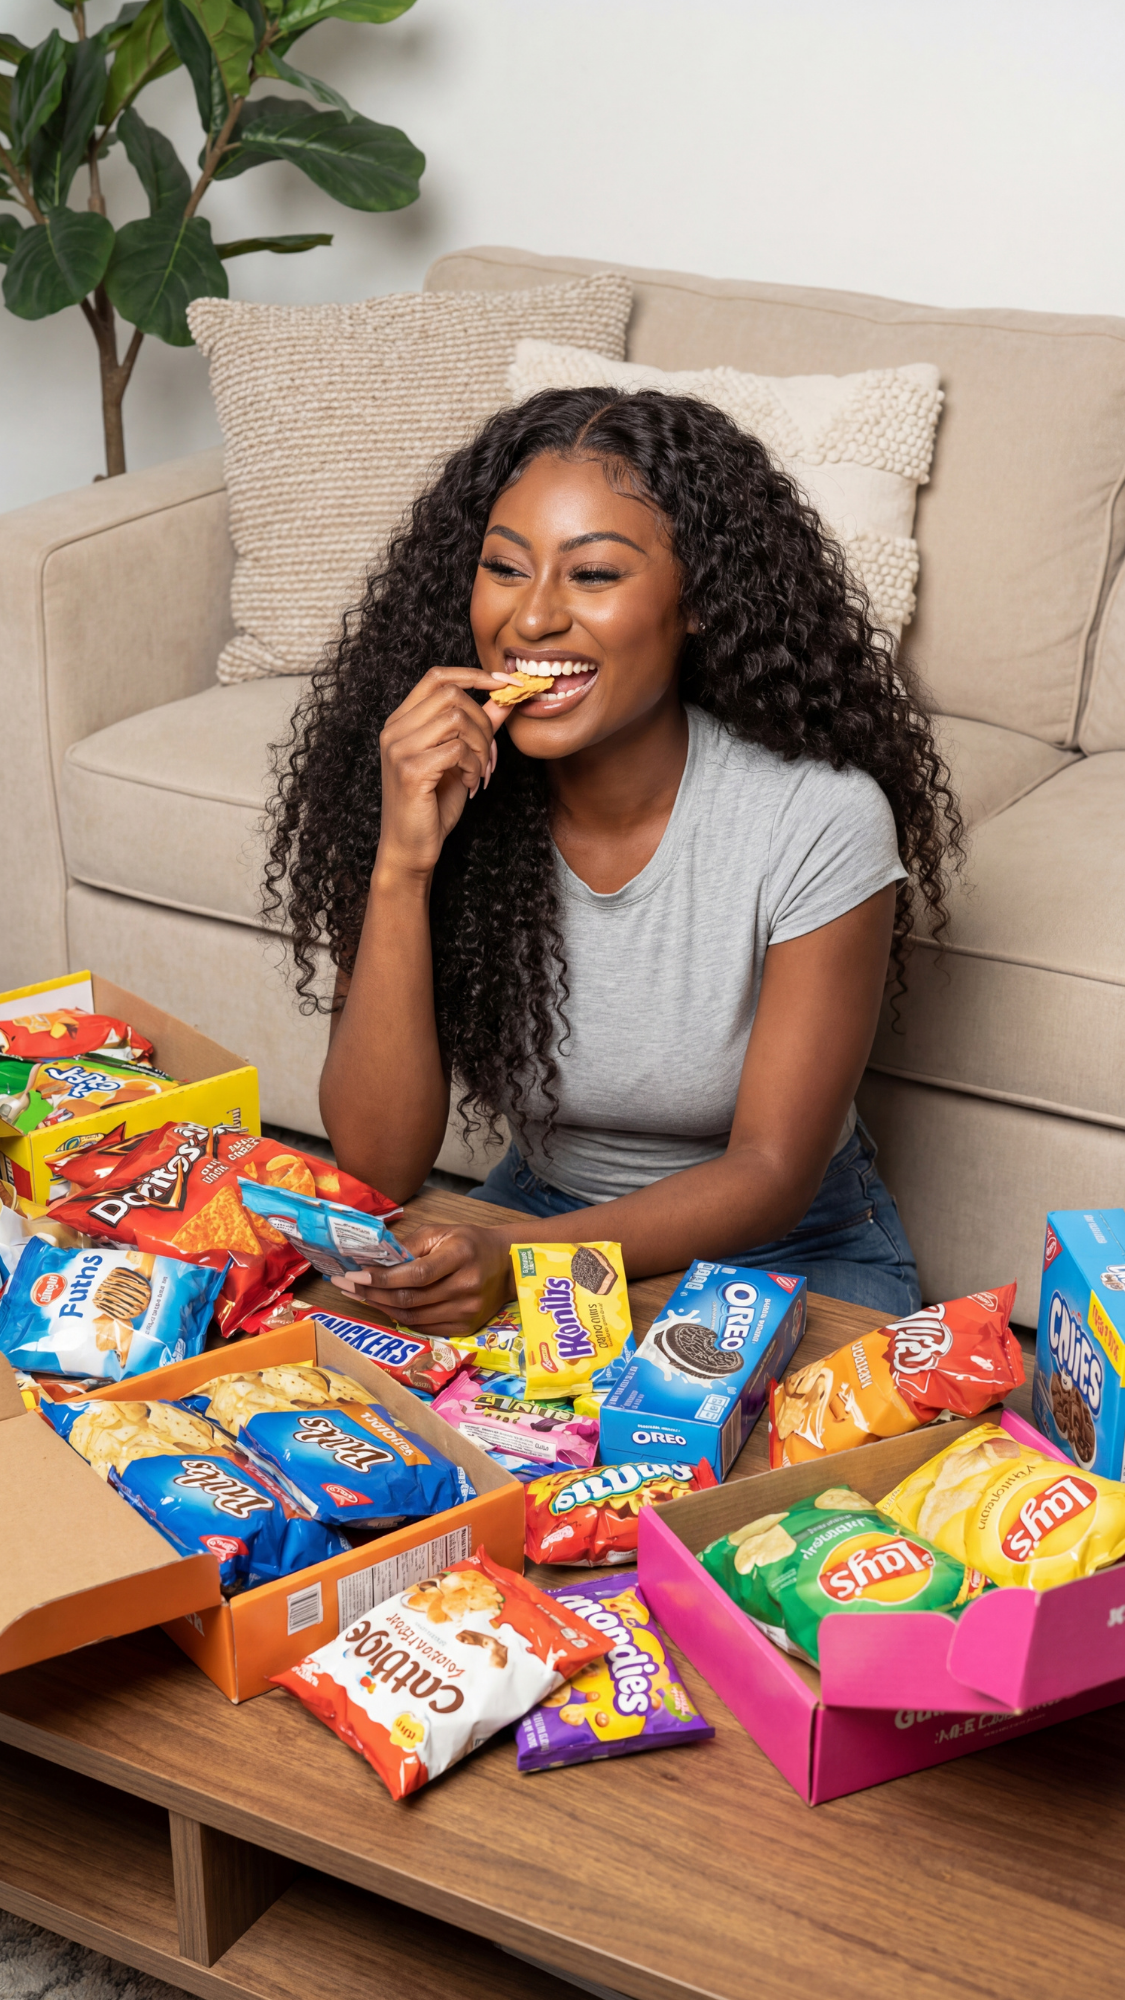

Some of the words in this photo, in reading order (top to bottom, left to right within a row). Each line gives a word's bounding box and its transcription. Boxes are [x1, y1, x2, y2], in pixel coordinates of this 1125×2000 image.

[719, 1282, 758, 1351] OREO
[632, 1431, 687, 1446] OREO
[1010, 1475, 1093, 1560] Lay's
[829, 1538, 926, 1601] Lay's
